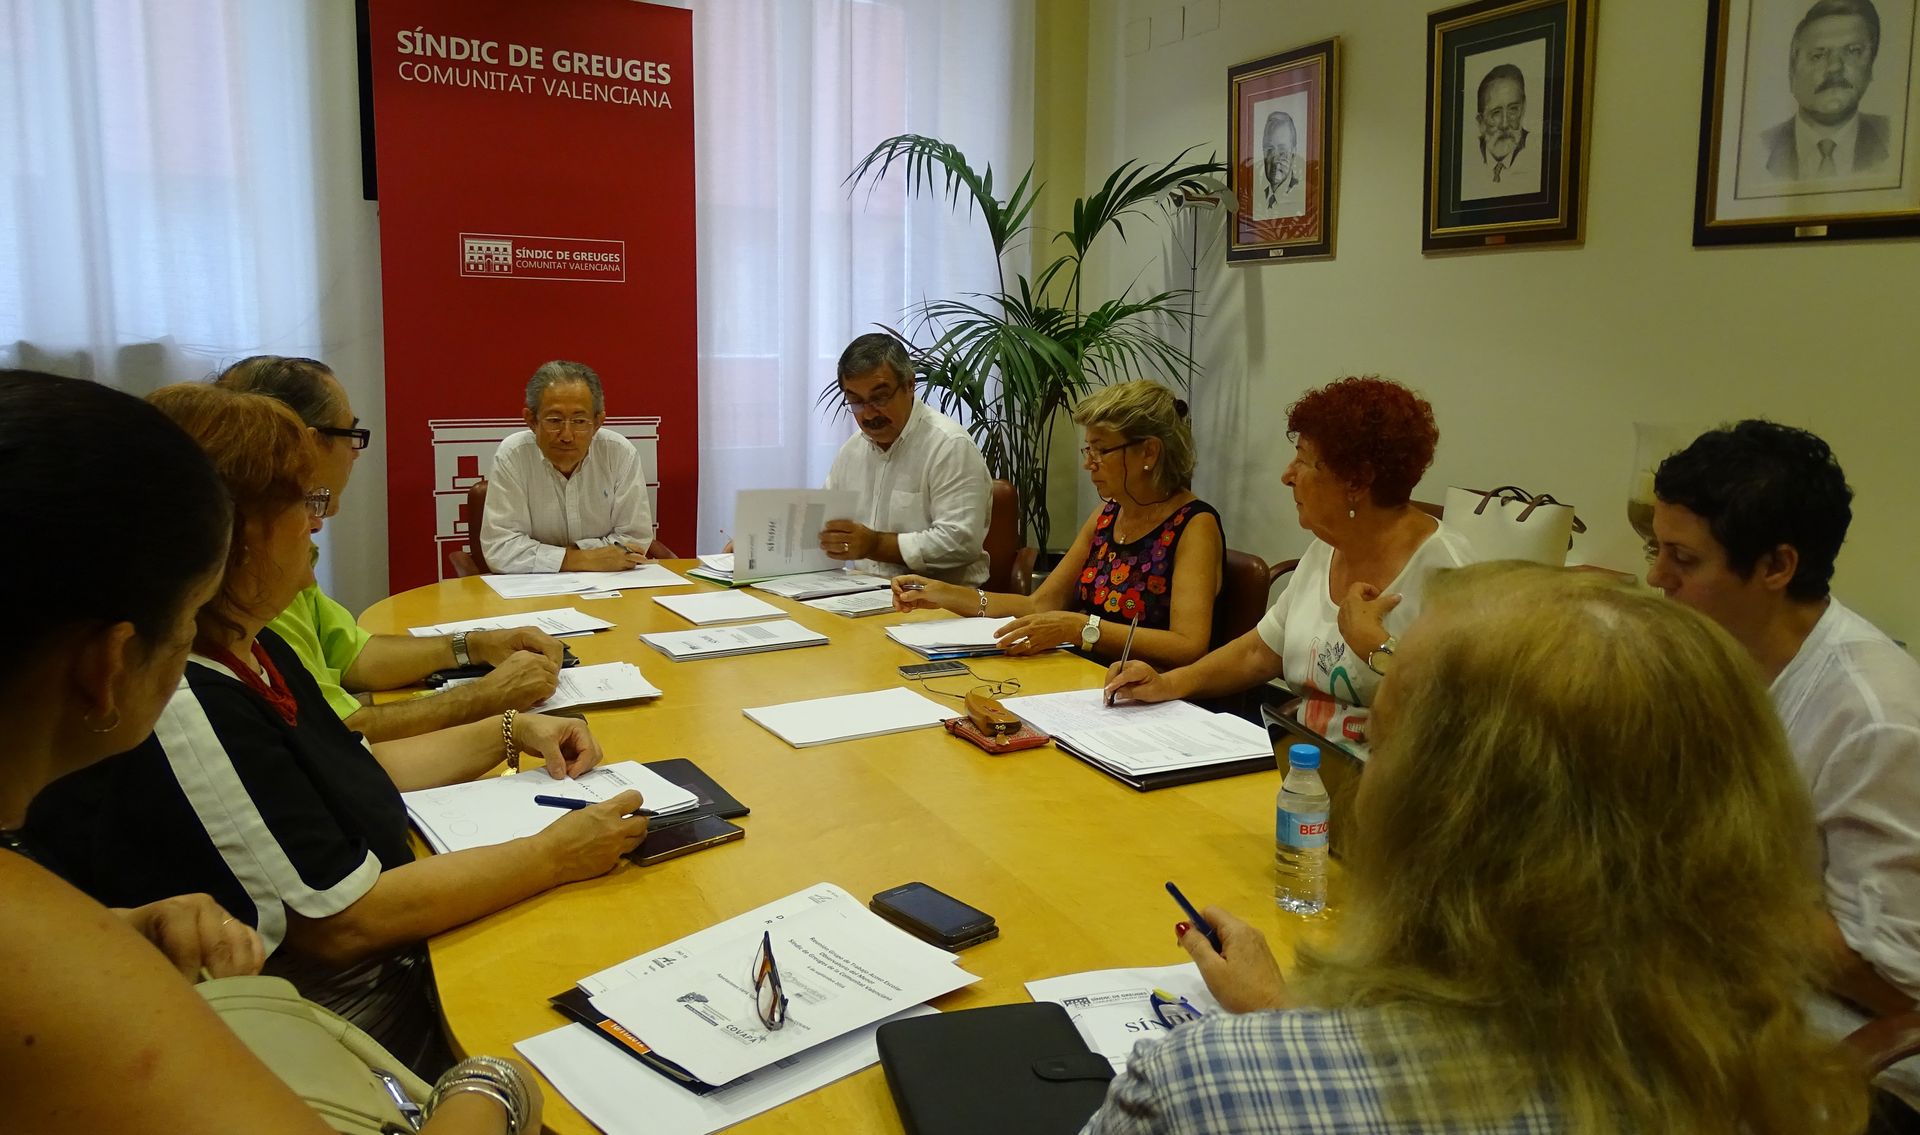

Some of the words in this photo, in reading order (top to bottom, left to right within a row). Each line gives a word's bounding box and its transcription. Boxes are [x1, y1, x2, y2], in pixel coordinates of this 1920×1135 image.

[397, 26, 499, 64] SÍNDIC
[508, 44, 544, 70] DE
[552, 50, 671, 85] GREUGES
[399, 61, 535, 94] COMUNITAT
[542, 77, 672, 109] VALENCIANA
[516, 247, 553, 260] SÍNDIC
[556, 252, 570, 260] DE
[572, 252, 620, 262] GREUGES
[516, 260, 566, 269] COMUNITAT
[569, 262, 621, 272] VALENCIANA
[726, 1024, 757, 1043] COVAPA
